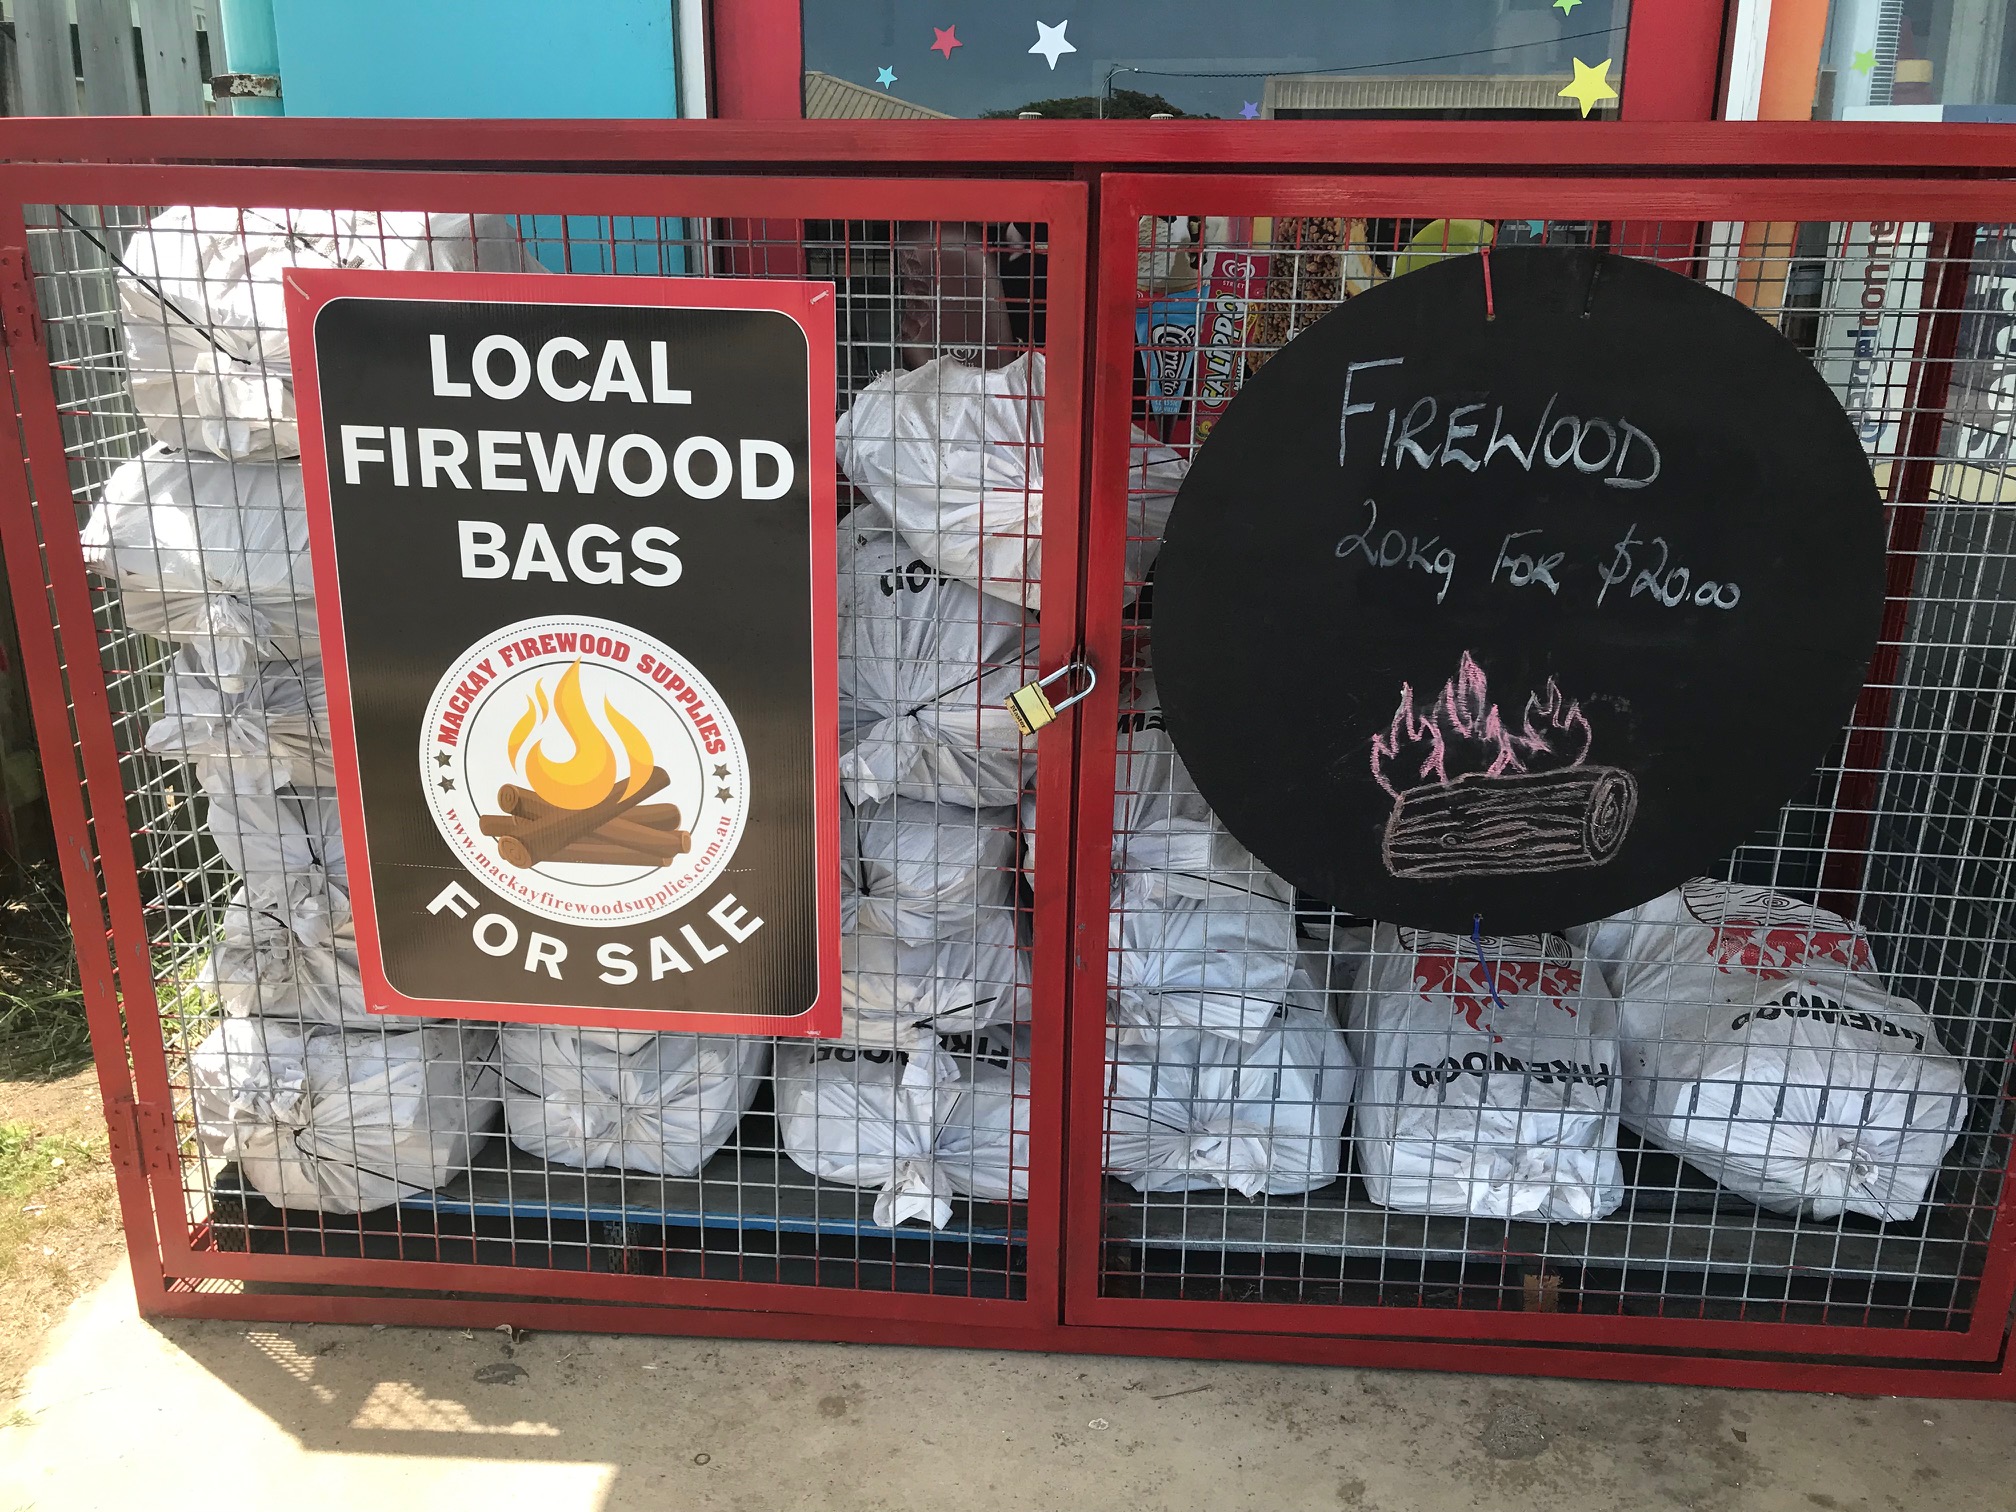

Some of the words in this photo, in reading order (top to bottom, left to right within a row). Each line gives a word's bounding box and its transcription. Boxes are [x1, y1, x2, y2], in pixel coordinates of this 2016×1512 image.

[1222, 280, 1252, 289] STRET
[429, 333, 692, 405] LOCAL
[340, 424, 795, 501] FIREWOOD
[1339, 356, 1662, 490] FIREWOOD
[456, 519, 683, 588] BAGS
[1597, 522, 1741, 610] $20.00
[437, 658, 498, 748] MACKAY
[498, 632, 631, 668] FIREWOOD
[636, 653, 727, 756] SUPPLIES
[445, 807, 733, 915] www.mackayfirewoodsupplies.com.au
[425, 880, 569, 981] FOR
[596, 893, 765, 986] SALE
[1411, 1051, 1610, 1089] FIREWOOD
